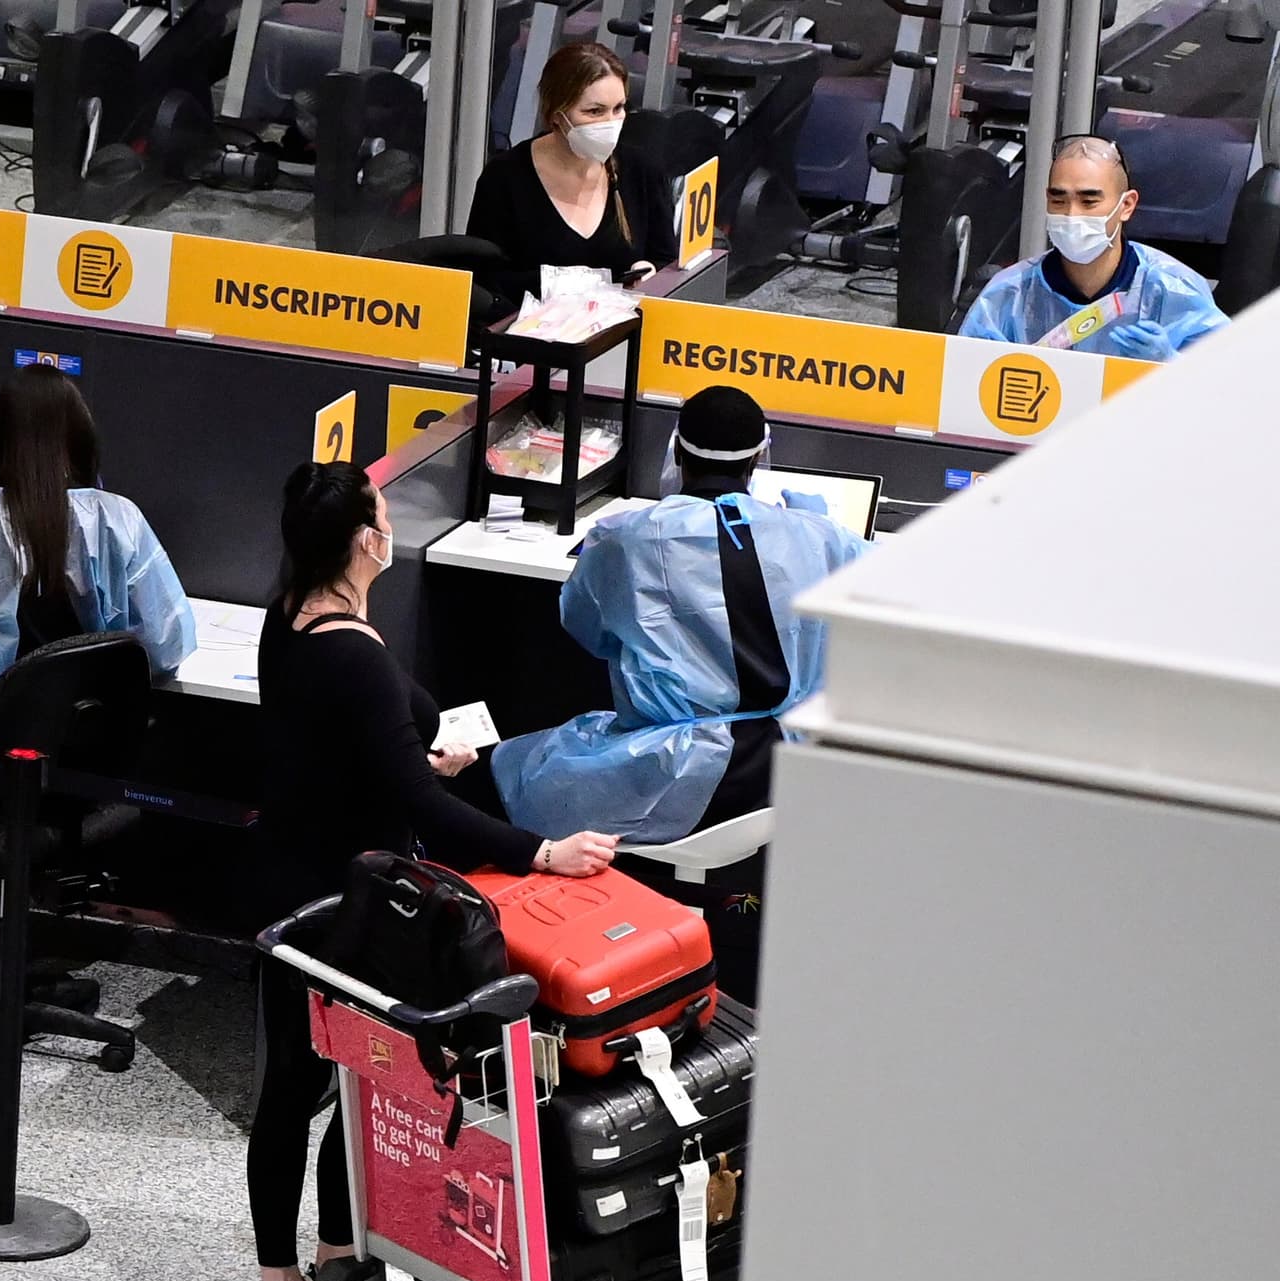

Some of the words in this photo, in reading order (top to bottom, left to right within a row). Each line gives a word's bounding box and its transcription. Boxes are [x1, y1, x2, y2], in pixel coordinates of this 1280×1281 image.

[689, 182, 711, 243] 10
[215, 278, 420, 330] INSCRIPTION
[662, 339, 905, 395] REGISTRATION
[327, 421, 344, 462] 2
[124, 788, 174, 806] bienvenue
[371, 1090, 382, 1113] A
[385, 1099, 413, 1128] free
[416, 1119, 444, 1144] cart
[371, 1113, 386, 1135] to
[390, 1126, 412, 1148] get
[415, 1138, 440, 1163] you
[373, 1134, 410, 1167] there
